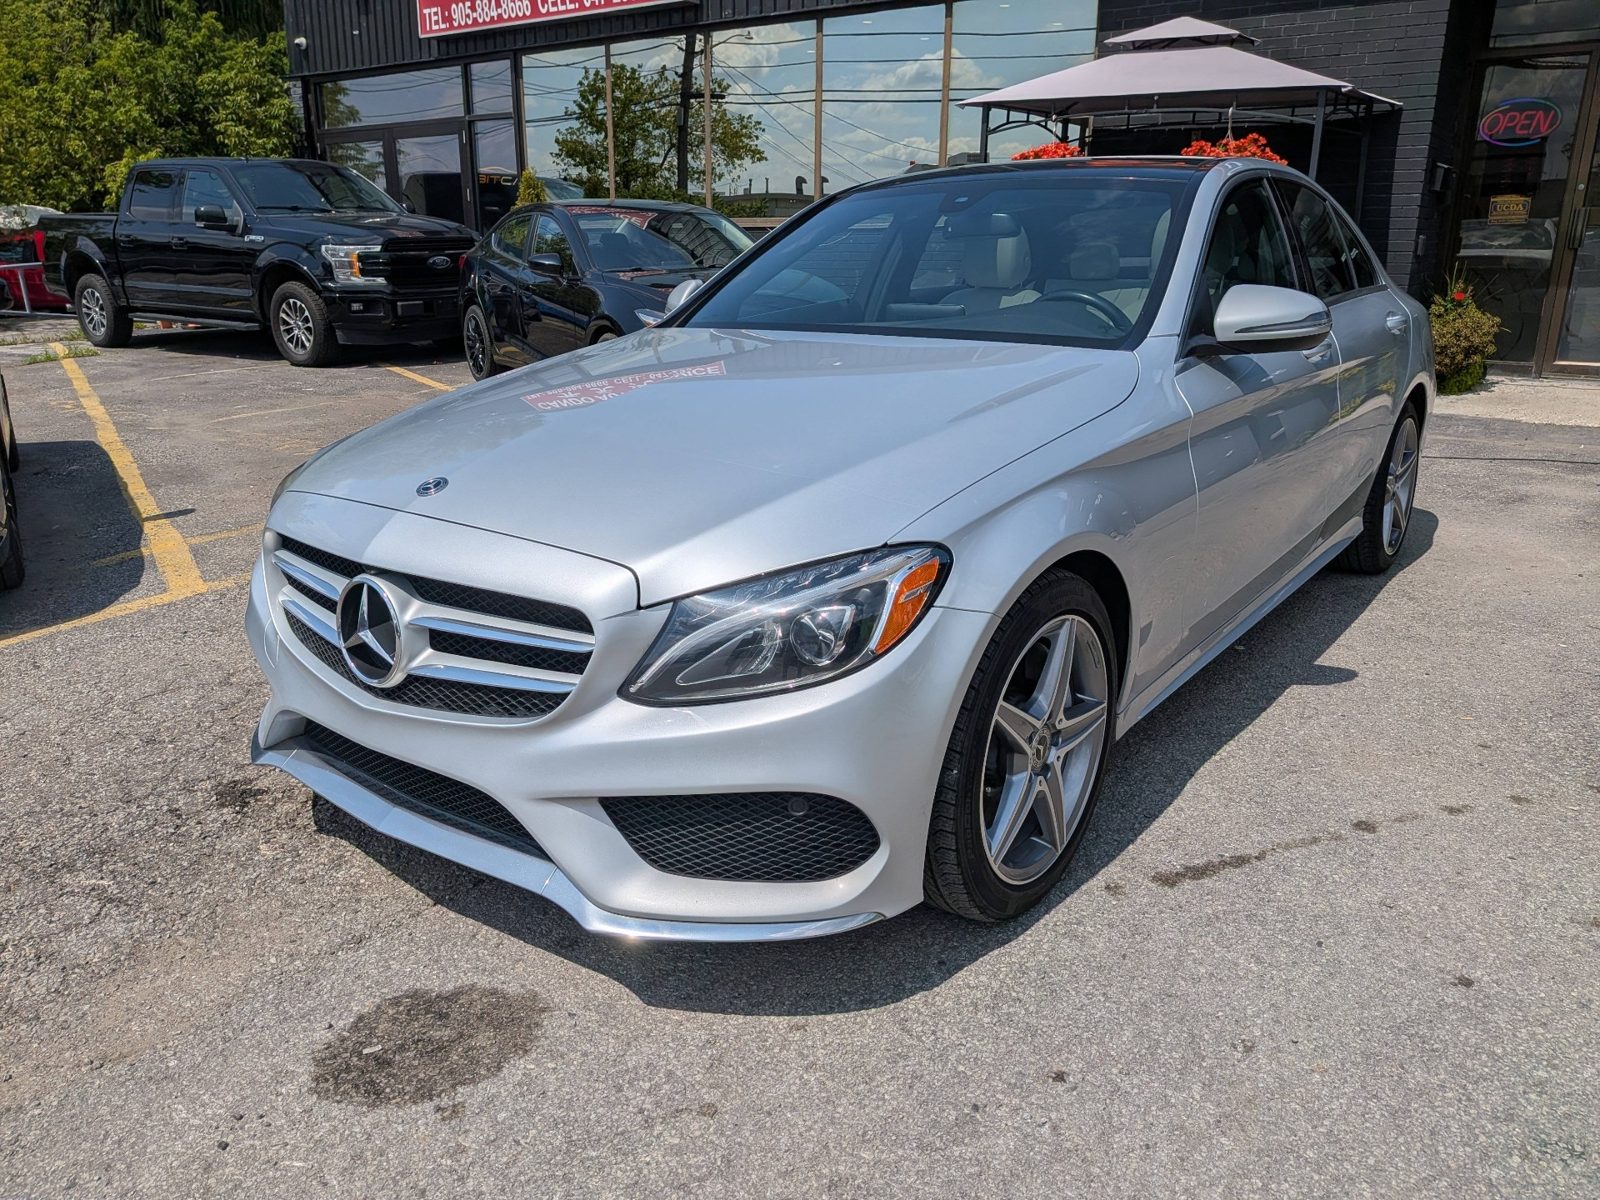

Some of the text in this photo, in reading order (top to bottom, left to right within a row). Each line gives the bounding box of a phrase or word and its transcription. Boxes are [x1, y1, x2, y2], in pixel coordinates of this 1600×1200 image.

[423, 7, 449, 31] TEL:
[451, 0, 531, 27] 905-884-8666
[1484, 110, 1555, 135] OPEN
[1496, 203, 1524, 211] UCDA
